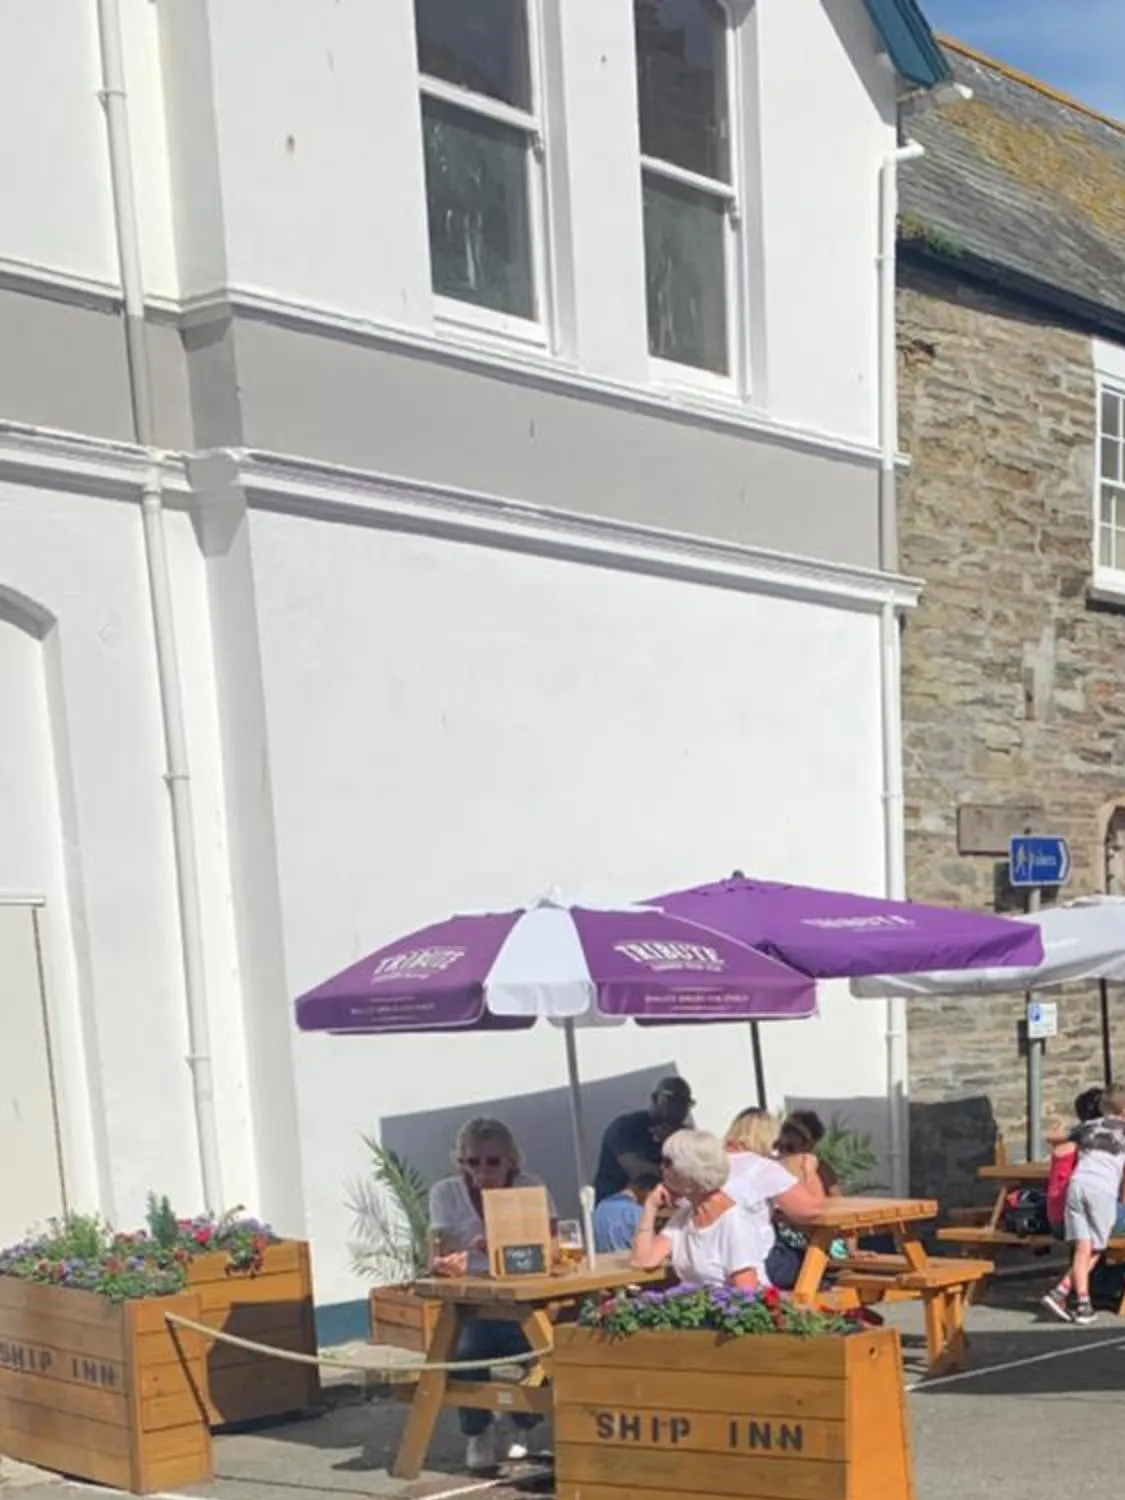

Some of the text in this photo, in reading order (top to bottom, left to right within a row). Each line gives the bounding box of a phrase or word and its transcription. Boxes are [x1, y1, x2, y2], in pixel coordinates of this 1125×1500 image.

[373, 950, 466, 976] TRIBUTE
[614, 942, 725, 964] TRIBUTE
[0, 1342, 117, 1386] SHIP INN
[596, 1412, 803, 1451] SHIP INN
